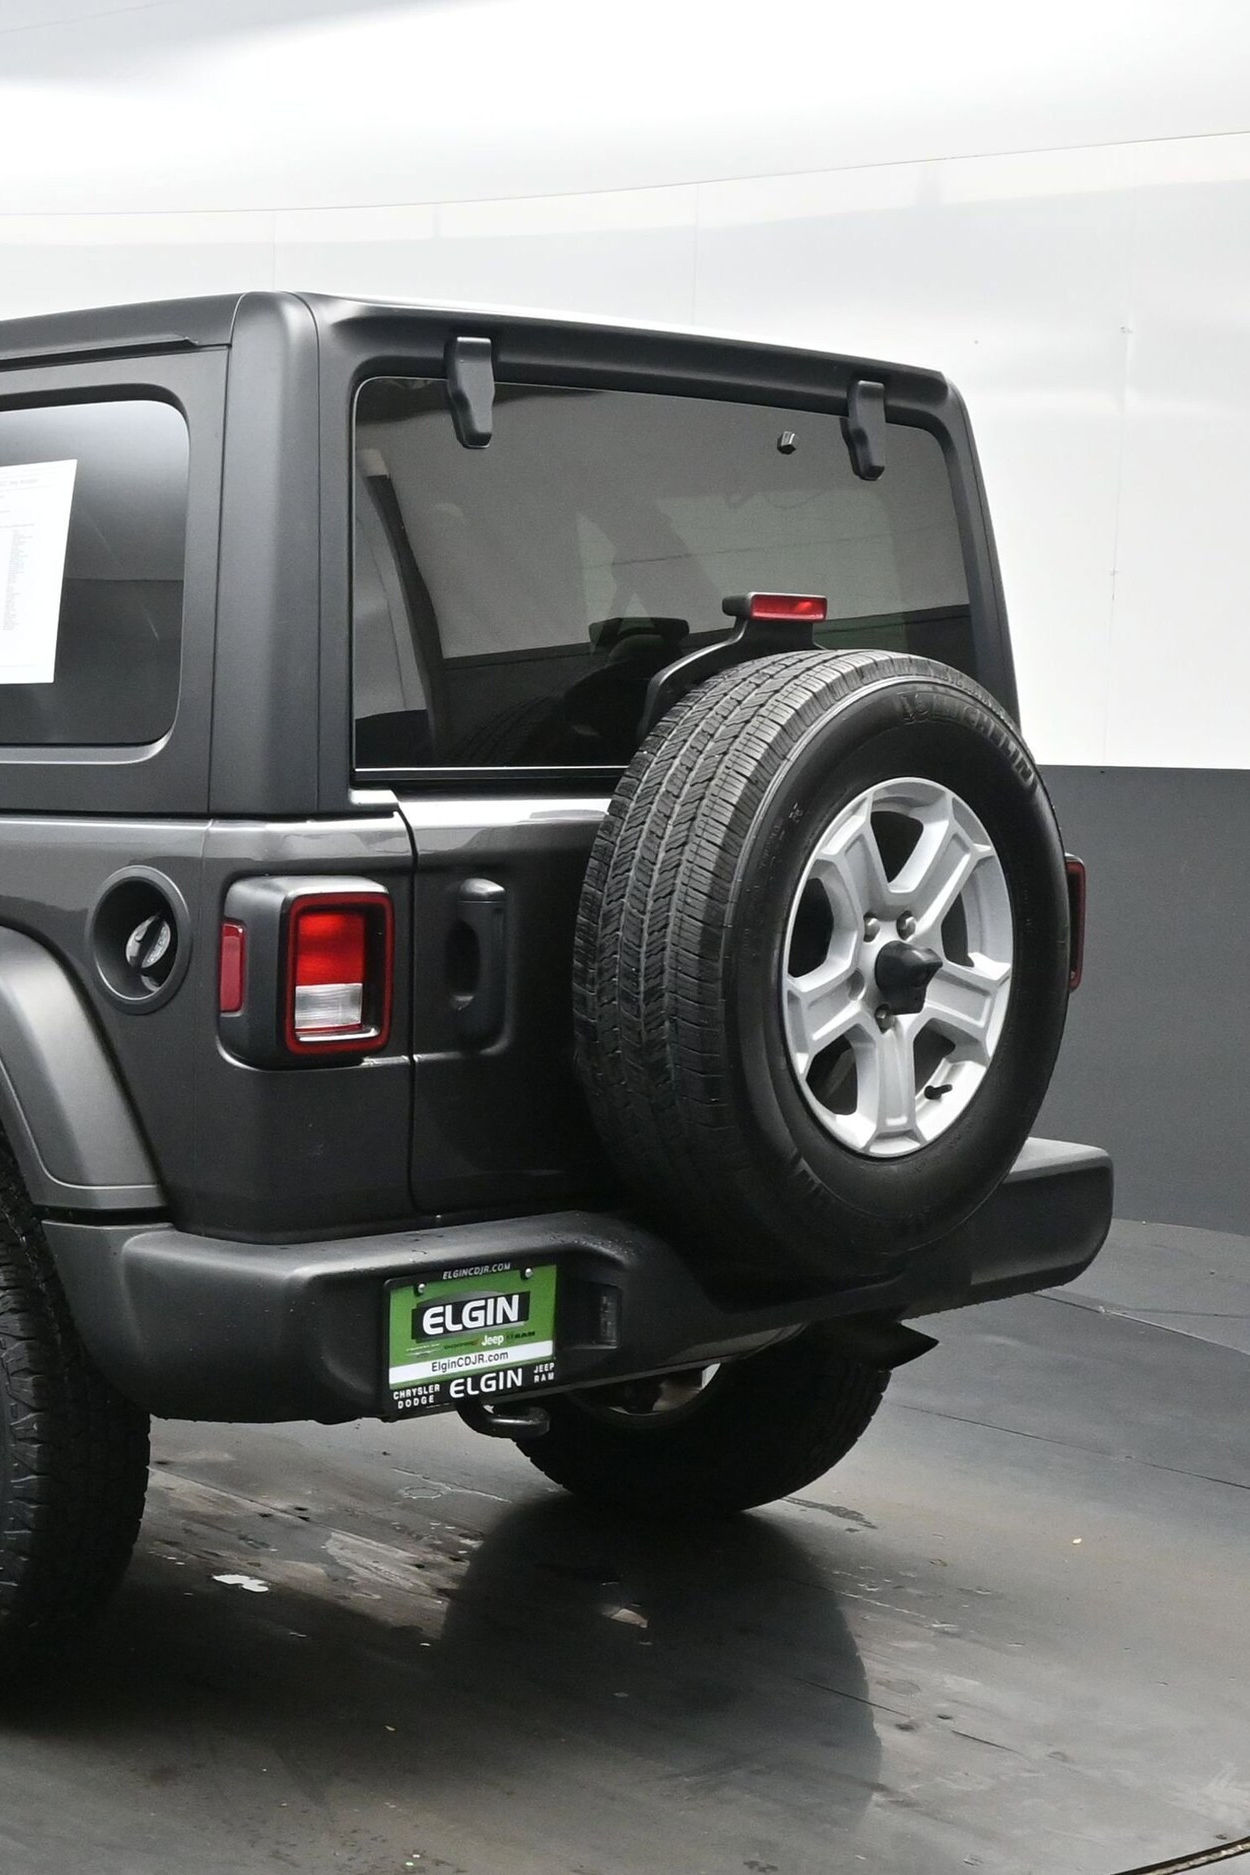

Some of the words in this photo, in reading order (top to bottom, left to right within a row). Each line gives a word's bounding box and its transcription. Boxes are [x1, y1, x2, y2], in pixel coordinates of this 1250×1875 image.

[442, 1262, 511, 1280] ELGINCDJR.COM
[422, 1294, 519, 1335] ELGIN
[481, 1334, 504, 1348] Jeep
[431, 1350, 509, 1373] ElginCDJR.com
[533, 1363, 556, 1374] JEEP
[449, 1368, 523, 1399] ELGIN
[534, 1373, 555, 1383] RAM
[393, 1384, 440, 1400] CHRYSLER
[397, 1395, 435, 1410] DODGE
